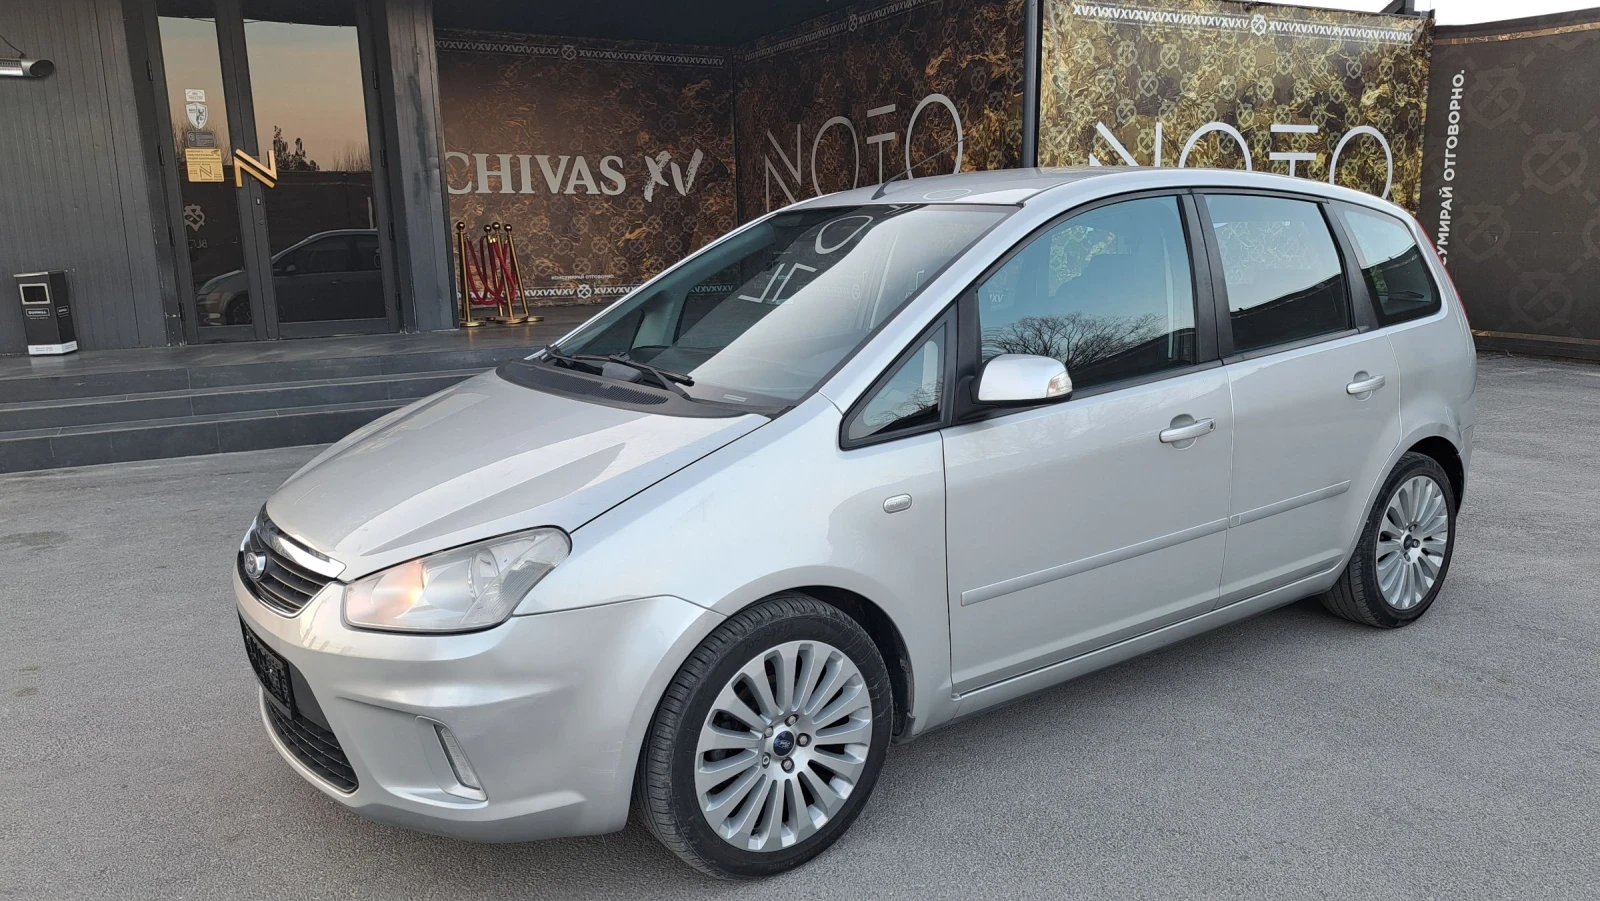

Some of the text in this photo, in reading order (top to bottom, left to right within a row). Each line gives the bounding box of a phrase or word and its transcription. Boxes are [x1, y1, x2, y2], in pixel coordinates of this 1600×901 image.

[445, 149, 704, 202] CHIVAS XV
[765, 94, 963, 212] NOTO
[1443, 69, 1465, 181] ОТГОВОРНО.
